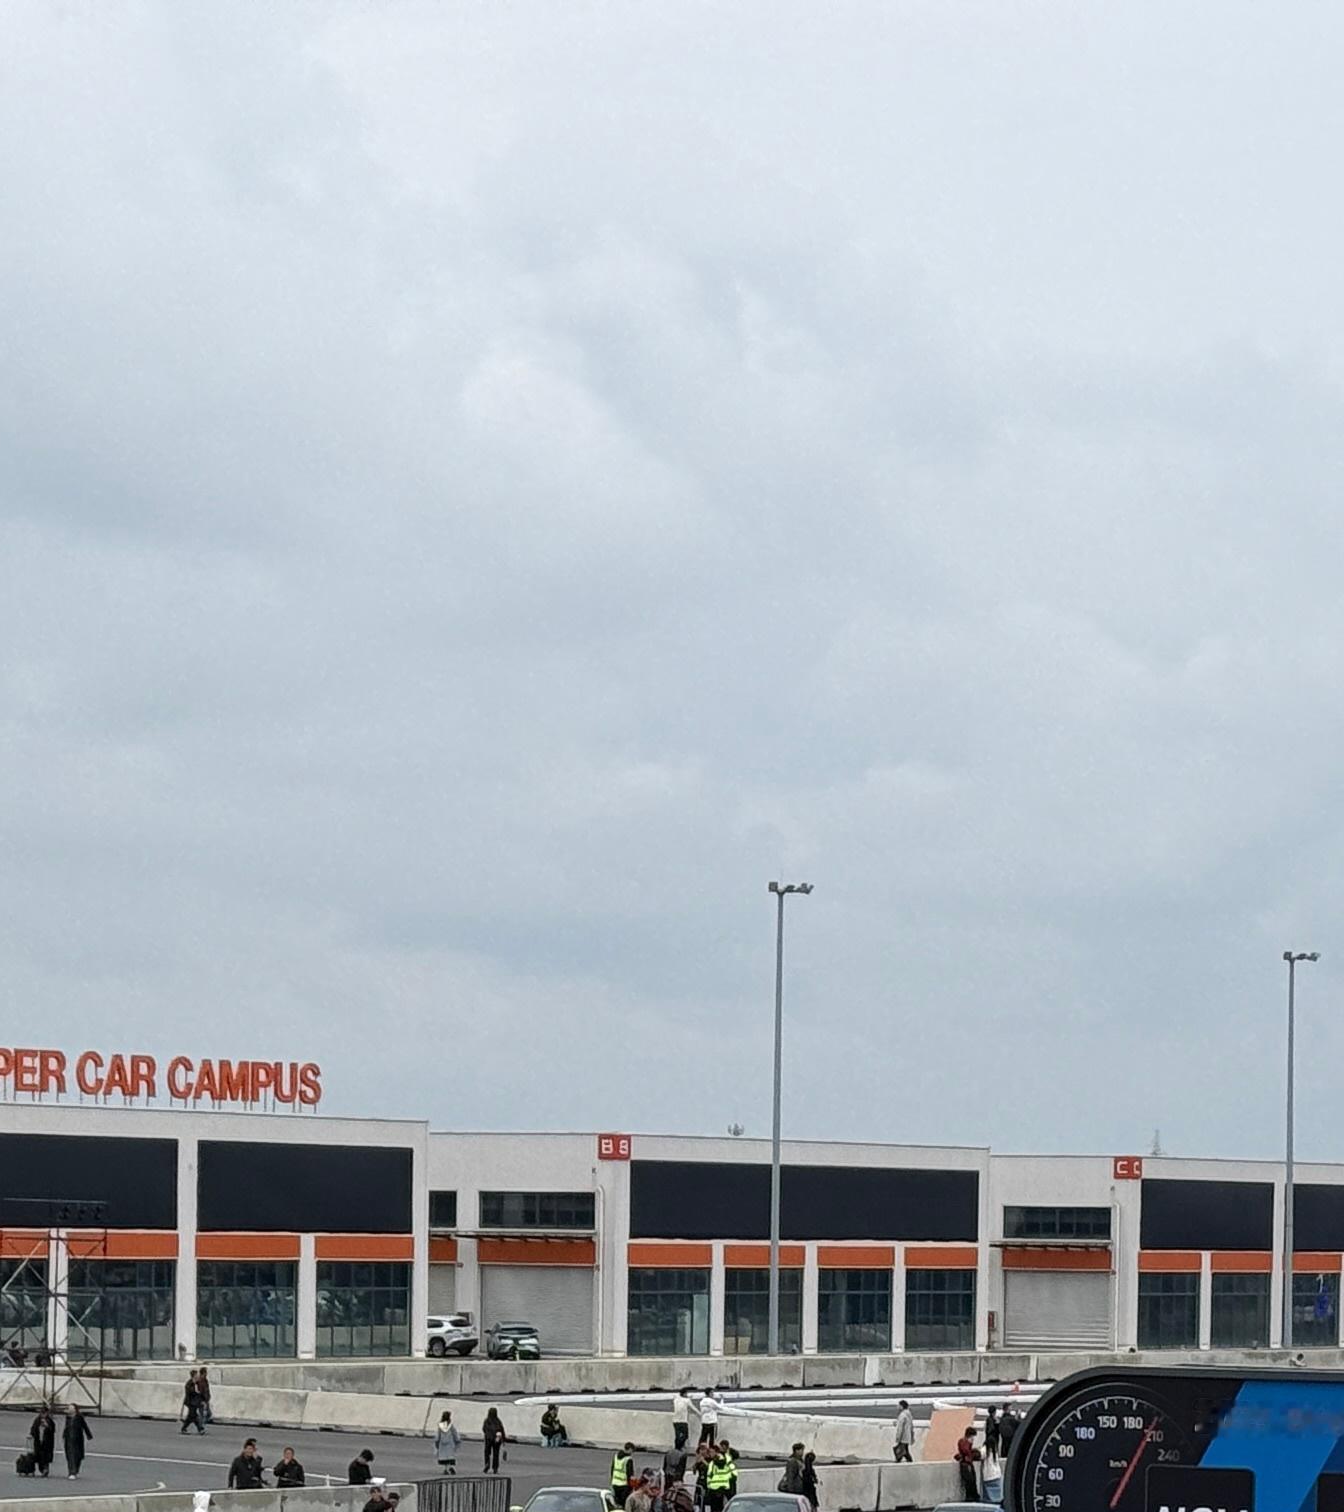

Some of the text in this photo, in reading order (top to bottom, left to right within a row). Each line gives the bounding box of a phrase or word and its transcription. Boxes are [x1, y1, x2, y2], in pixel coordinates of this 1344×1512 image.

[76, 1051, 157, 1097] CAR
[167, 1056, 322, 1105] CAMPUS
[1097, 1416, 1117, 1429] 150
[1123, 1417, 1144, 1429] 180
[1074, 1427, 1096, 1440] 180
[1059, 1444, 1074, 1458] 90
[1157, 1449, 1180, 1462] 240
[1048, 1468, 1064, 1480] 60
[1045, 1495, 1061, 1507] 30
